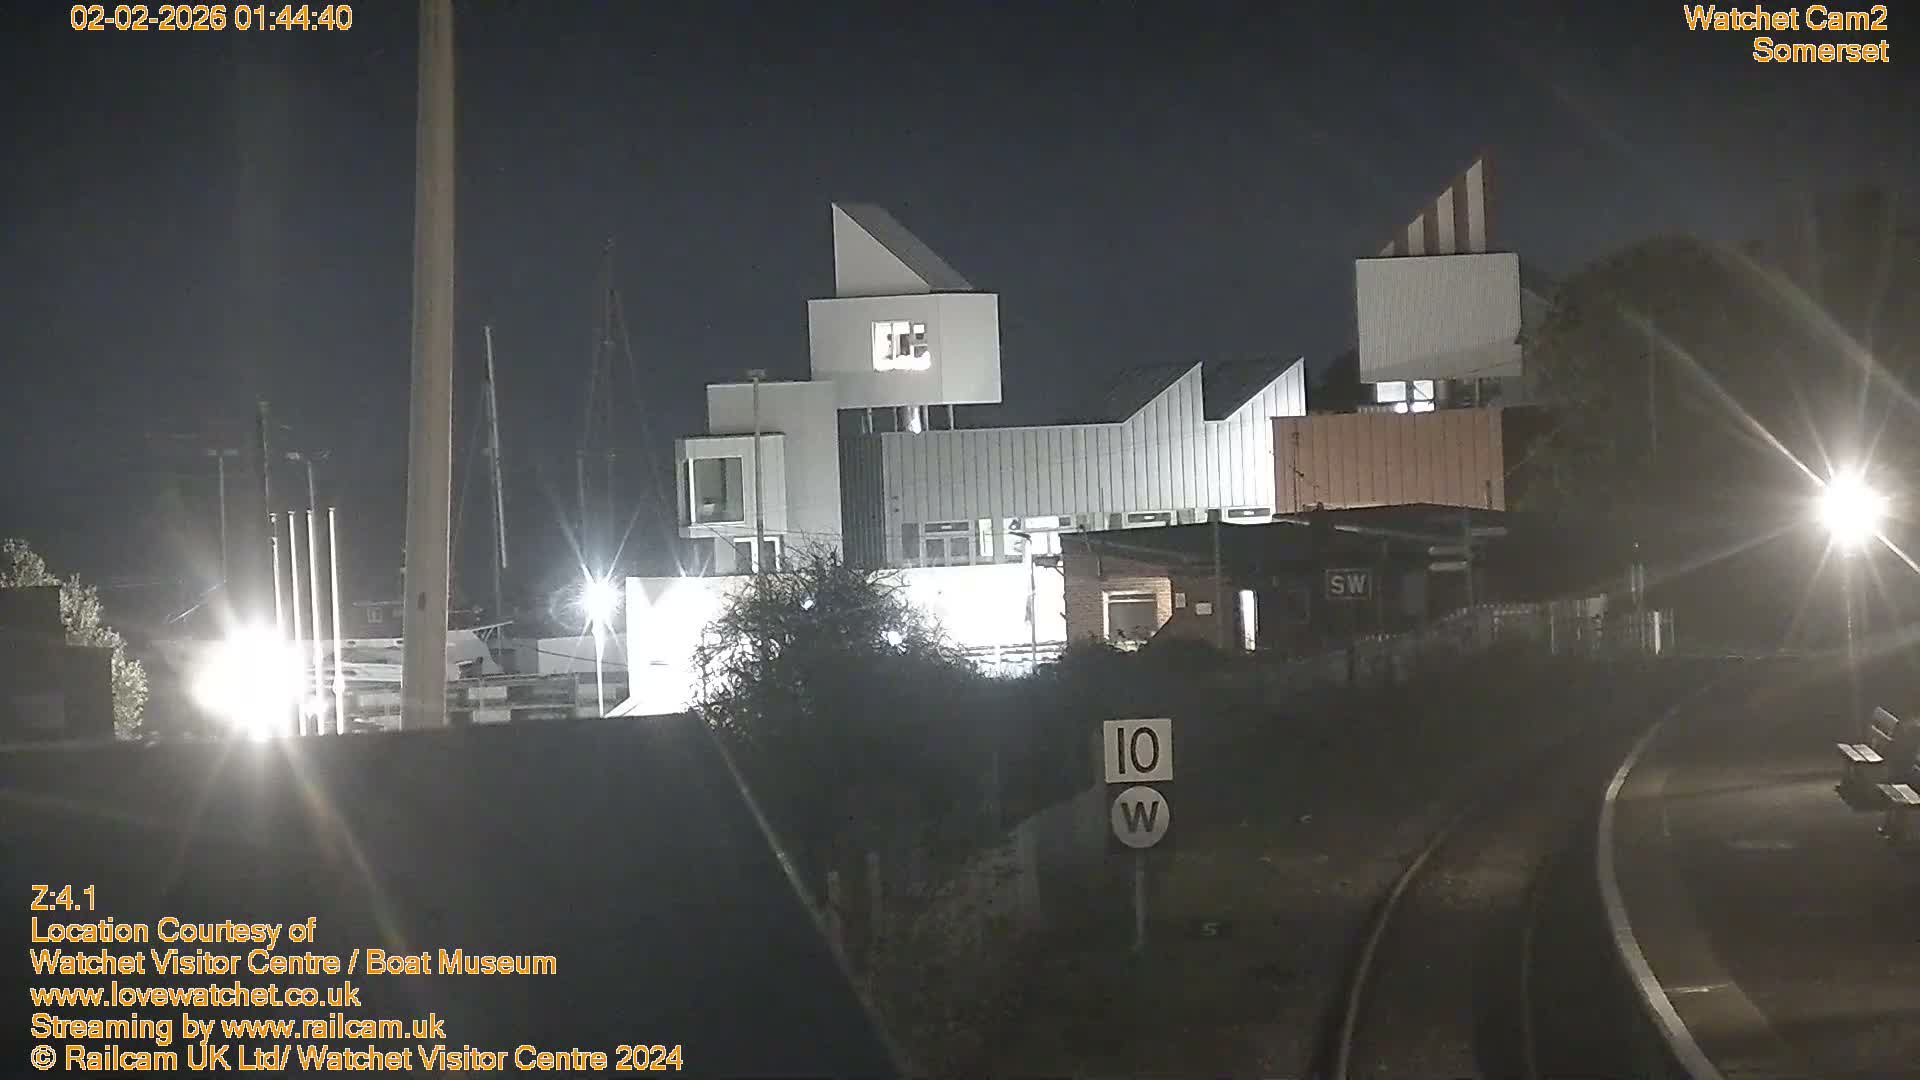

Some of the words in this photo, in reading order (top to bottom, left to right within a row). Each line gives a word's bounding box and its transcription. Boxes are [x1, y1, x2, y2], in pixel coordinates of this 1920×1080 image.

[1331, 574, 1366, 594] SW
[1117, 726, 1160, 774] 10
[1120, 801, 1159, 833] W
